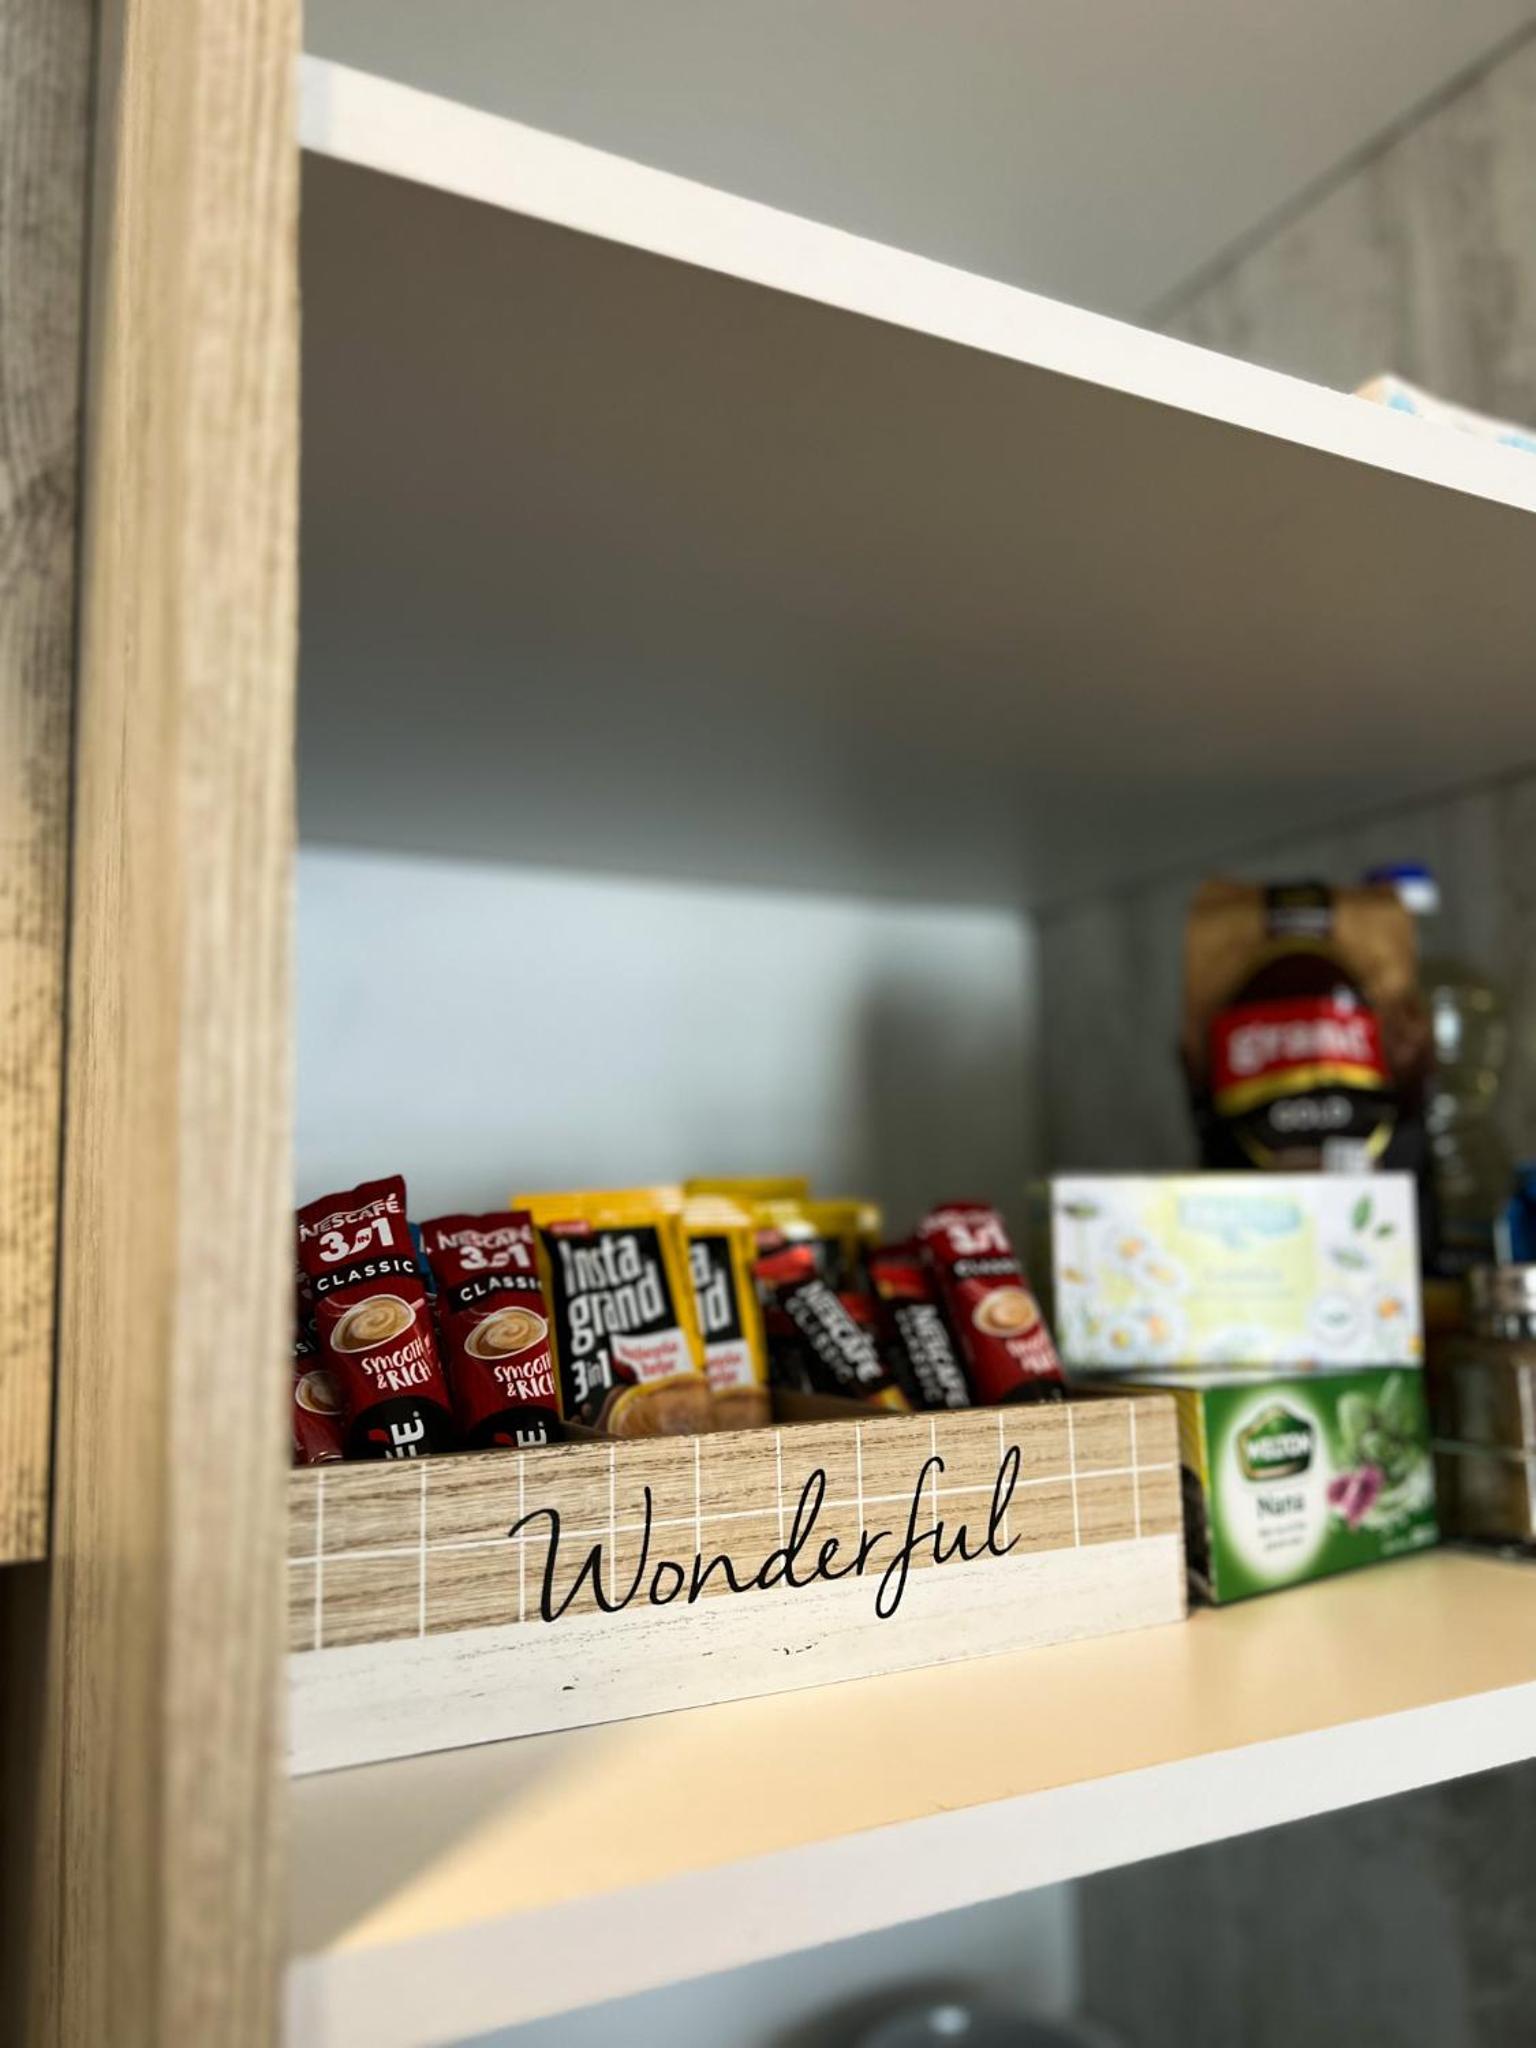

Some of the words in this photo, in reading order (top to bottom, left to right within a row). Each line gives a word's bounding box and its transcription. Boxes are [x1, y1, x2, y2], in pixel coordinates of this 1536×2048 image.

[298, 1193, 402, 1242] NESCAFÉ
[317, 1260, 414, 1291] CLASSIC
[557, 1234, 642, 1297] Insta
[568, 1261, 664, 1356] grand
[361, 1336, 424, 1375] SMOOTH
[385, 1358, 432, 1391] RICH
[508, 1445, 1021, 1623] Wonderful
